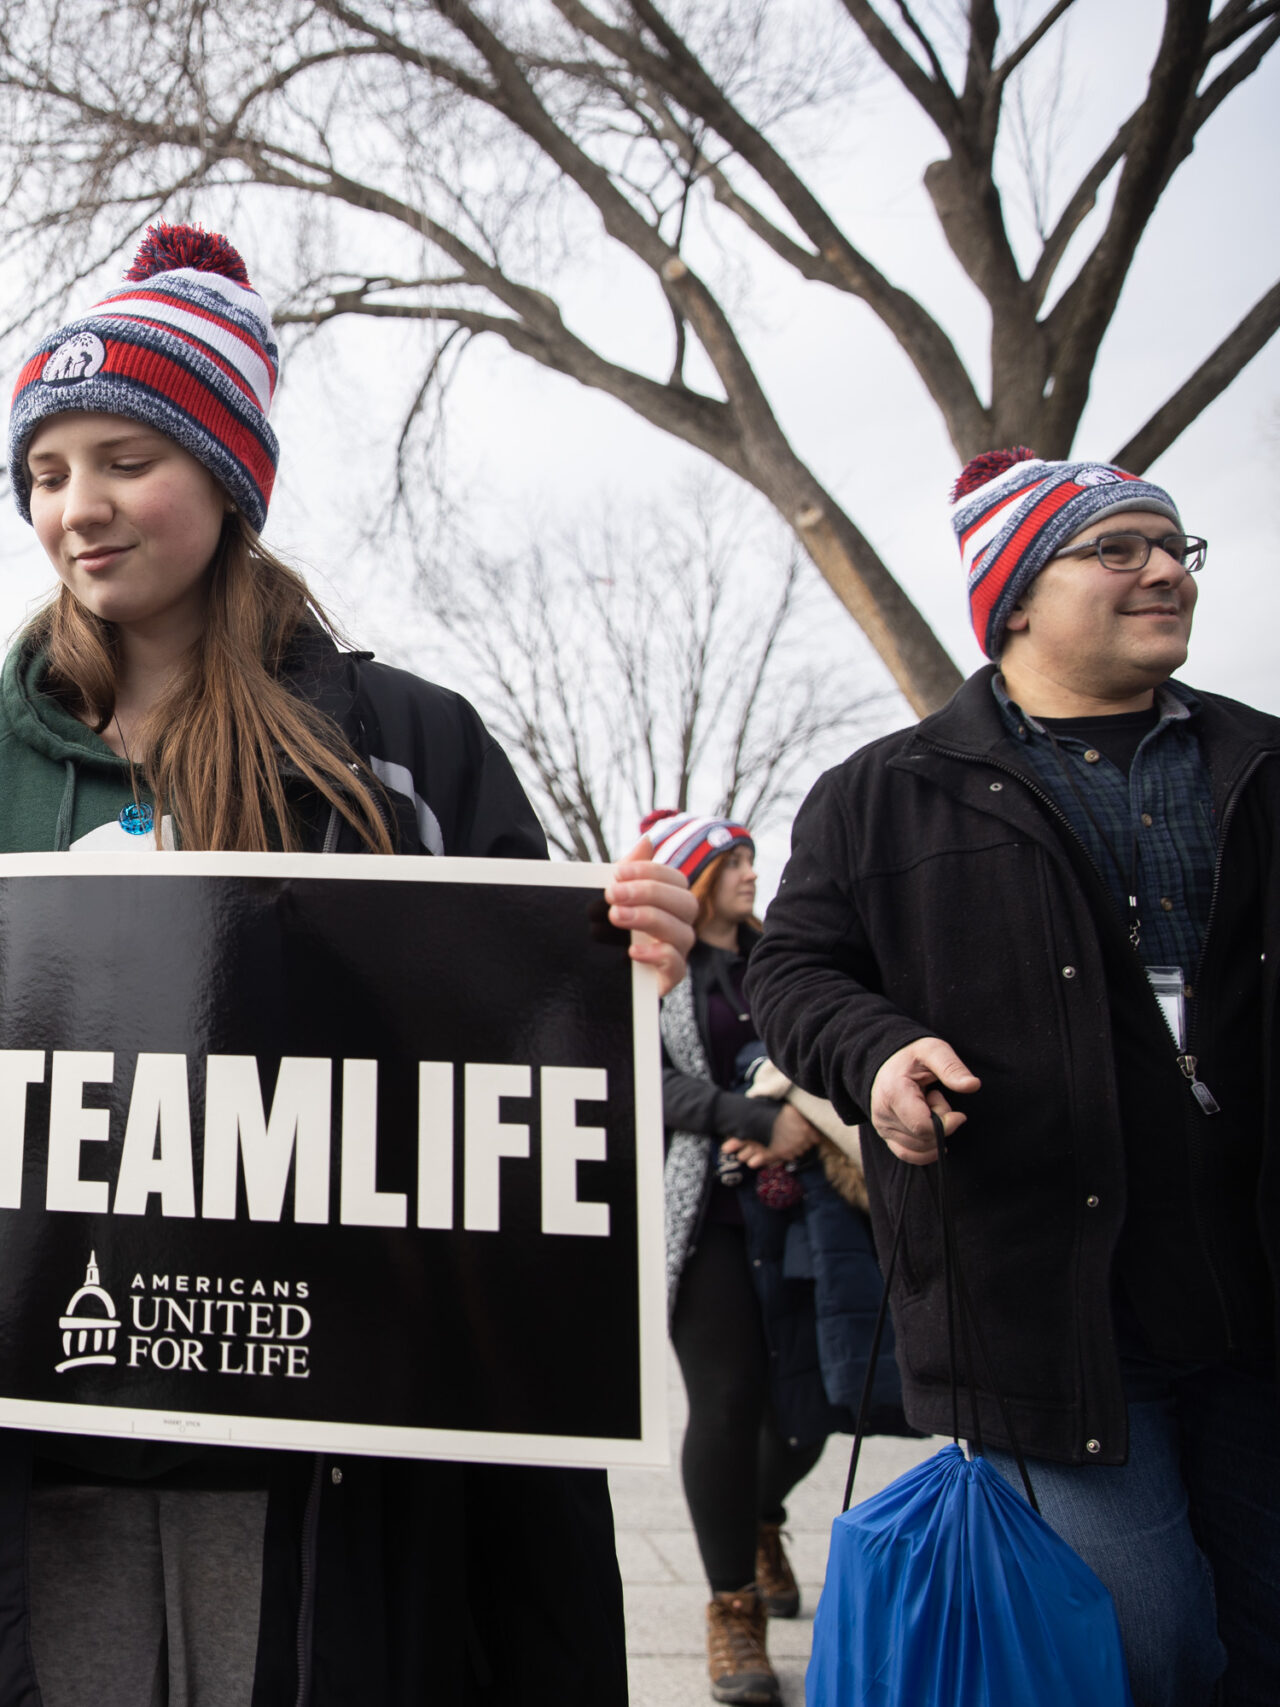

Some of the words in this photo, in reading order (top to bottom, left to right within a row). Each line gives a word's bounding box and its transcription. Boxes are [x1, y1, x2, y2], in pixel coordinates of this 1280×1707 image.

[131, 1273, 309, 1299] AMERICANS
[130, 1295, 311, 1340] UNITED
[126, 1335, 208, 1372] FOR
[218, 1341, 311, 1378] LIFE
